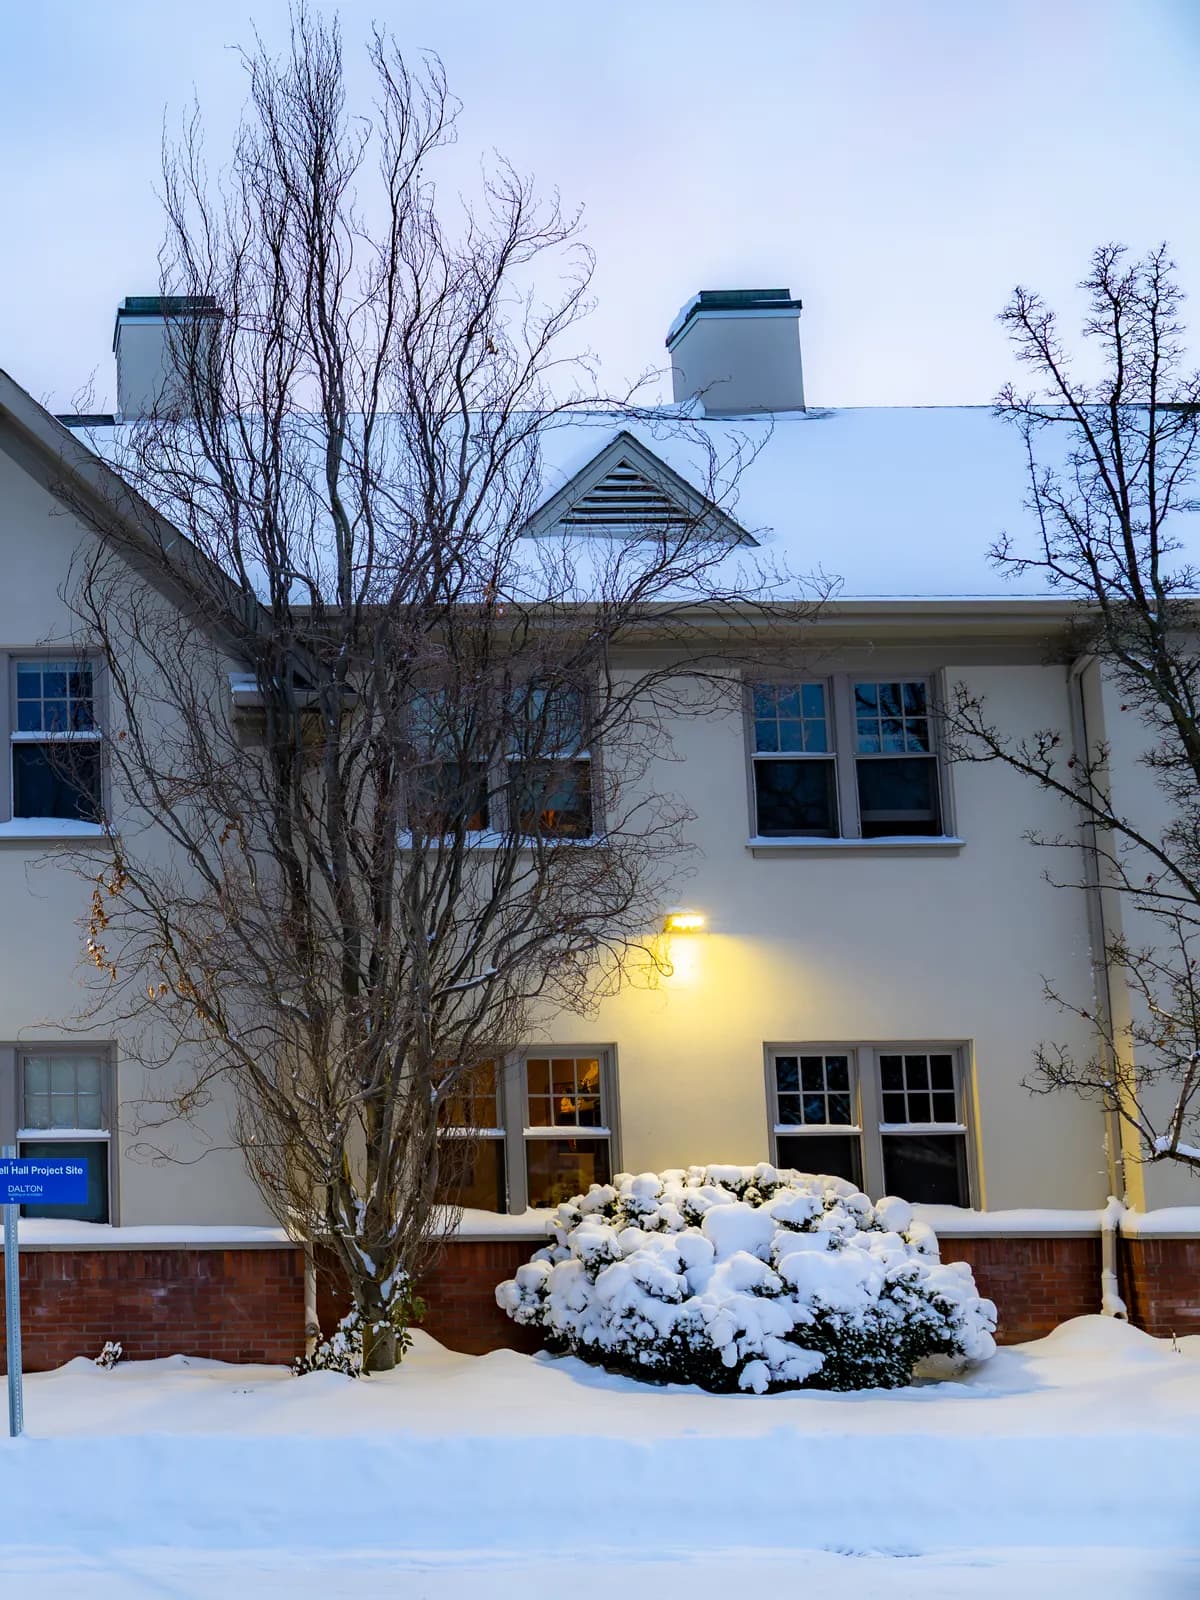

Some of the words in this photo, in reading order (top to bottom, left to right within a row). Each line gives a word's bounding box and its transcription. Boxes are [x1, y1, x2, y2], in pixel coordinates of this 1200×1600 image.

[11, 1166, 29, 1175] Hall
[31, 1166, 63, 1177] Project
[65, 1166, 83, 1175] Site
[7, 1184, 43, 1193] DALTON
